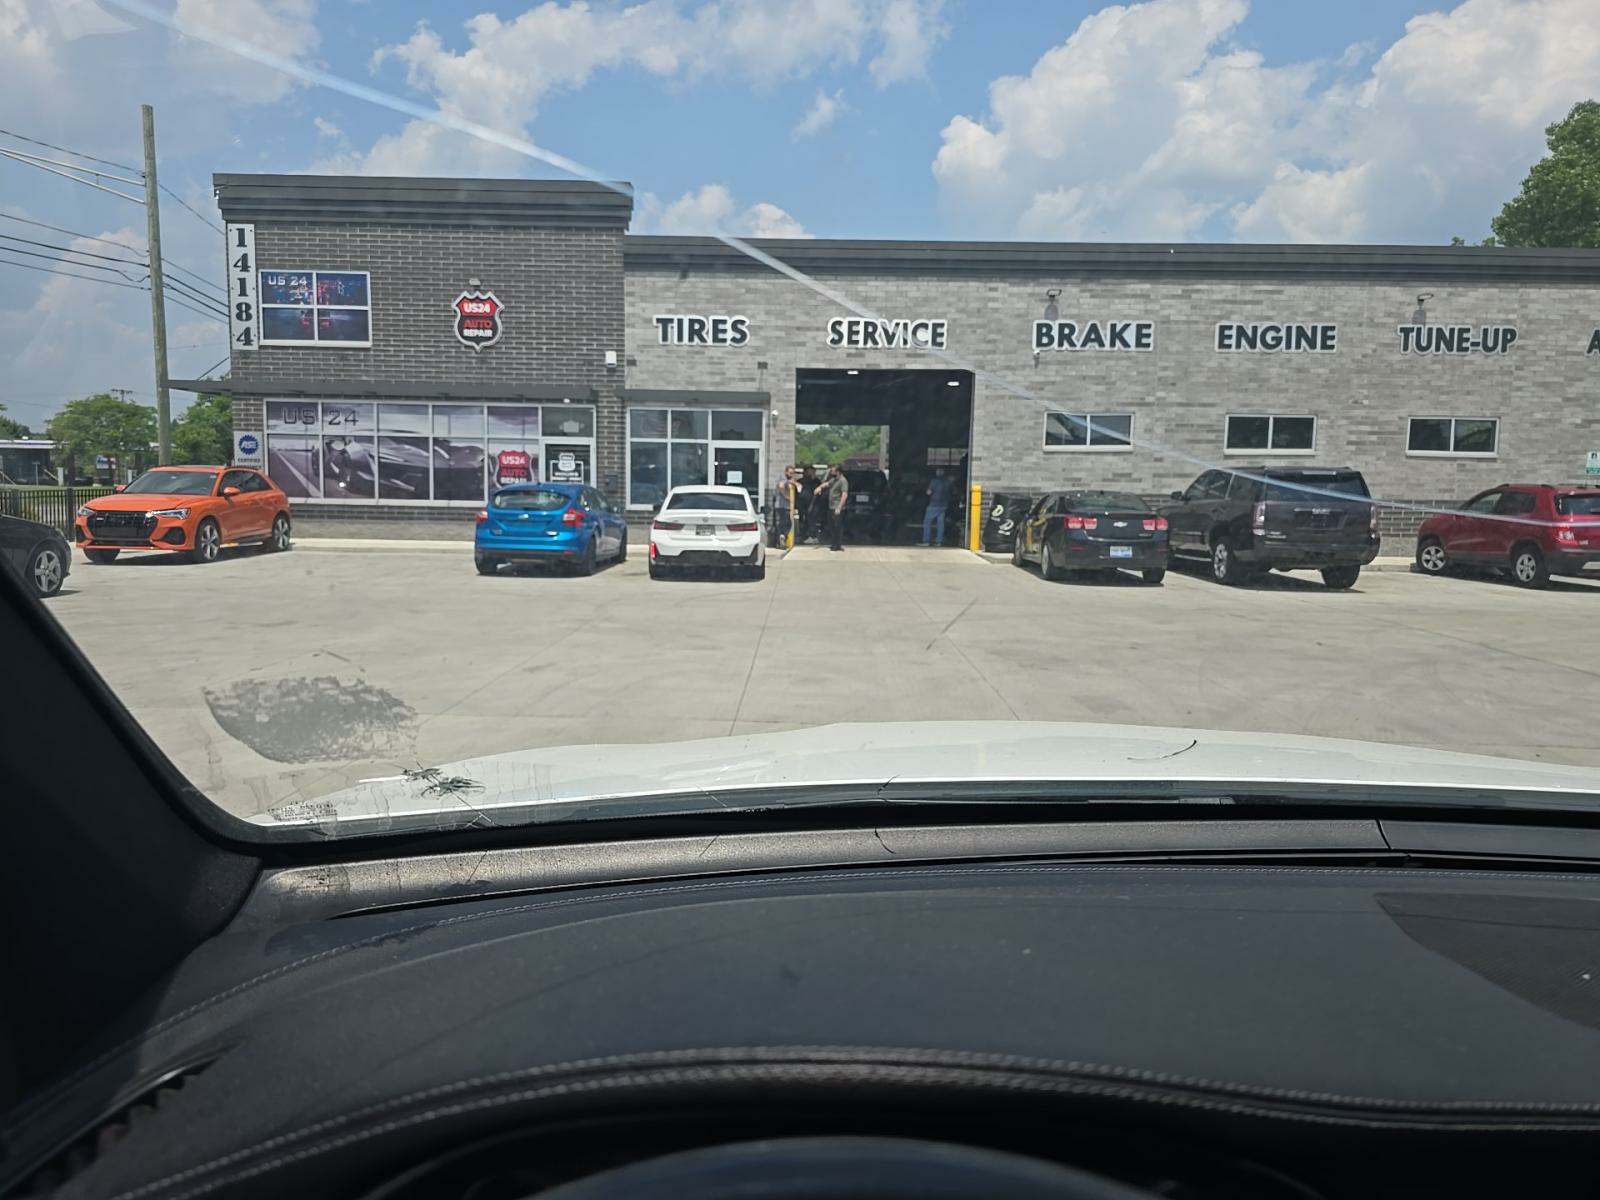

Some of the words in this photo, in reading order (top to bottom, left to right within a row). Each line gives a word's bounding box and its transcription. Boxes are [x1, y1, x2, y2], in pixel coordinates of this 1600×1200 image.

[233, 228, 254, 346] 14184
[268, 276, 286, 286] US
[290, 276, 307, 286] 24
[463, 303, 491, 313] US24
[463, 320, 493, 329] AUTO
[463, 329, 493, 338] REPAIR
[654, 316, 749, 345] TIRES
[828, 318, 947, 348] SERVICE
[1034, 321, 1153, 350] BRAKE
[1216, 323, 1337, 351] ENGINE
[1398, 325, 1519, 354] TUNE-UP
[283, 407, 316, 425] US
[328, 409, 360, 427] 24
